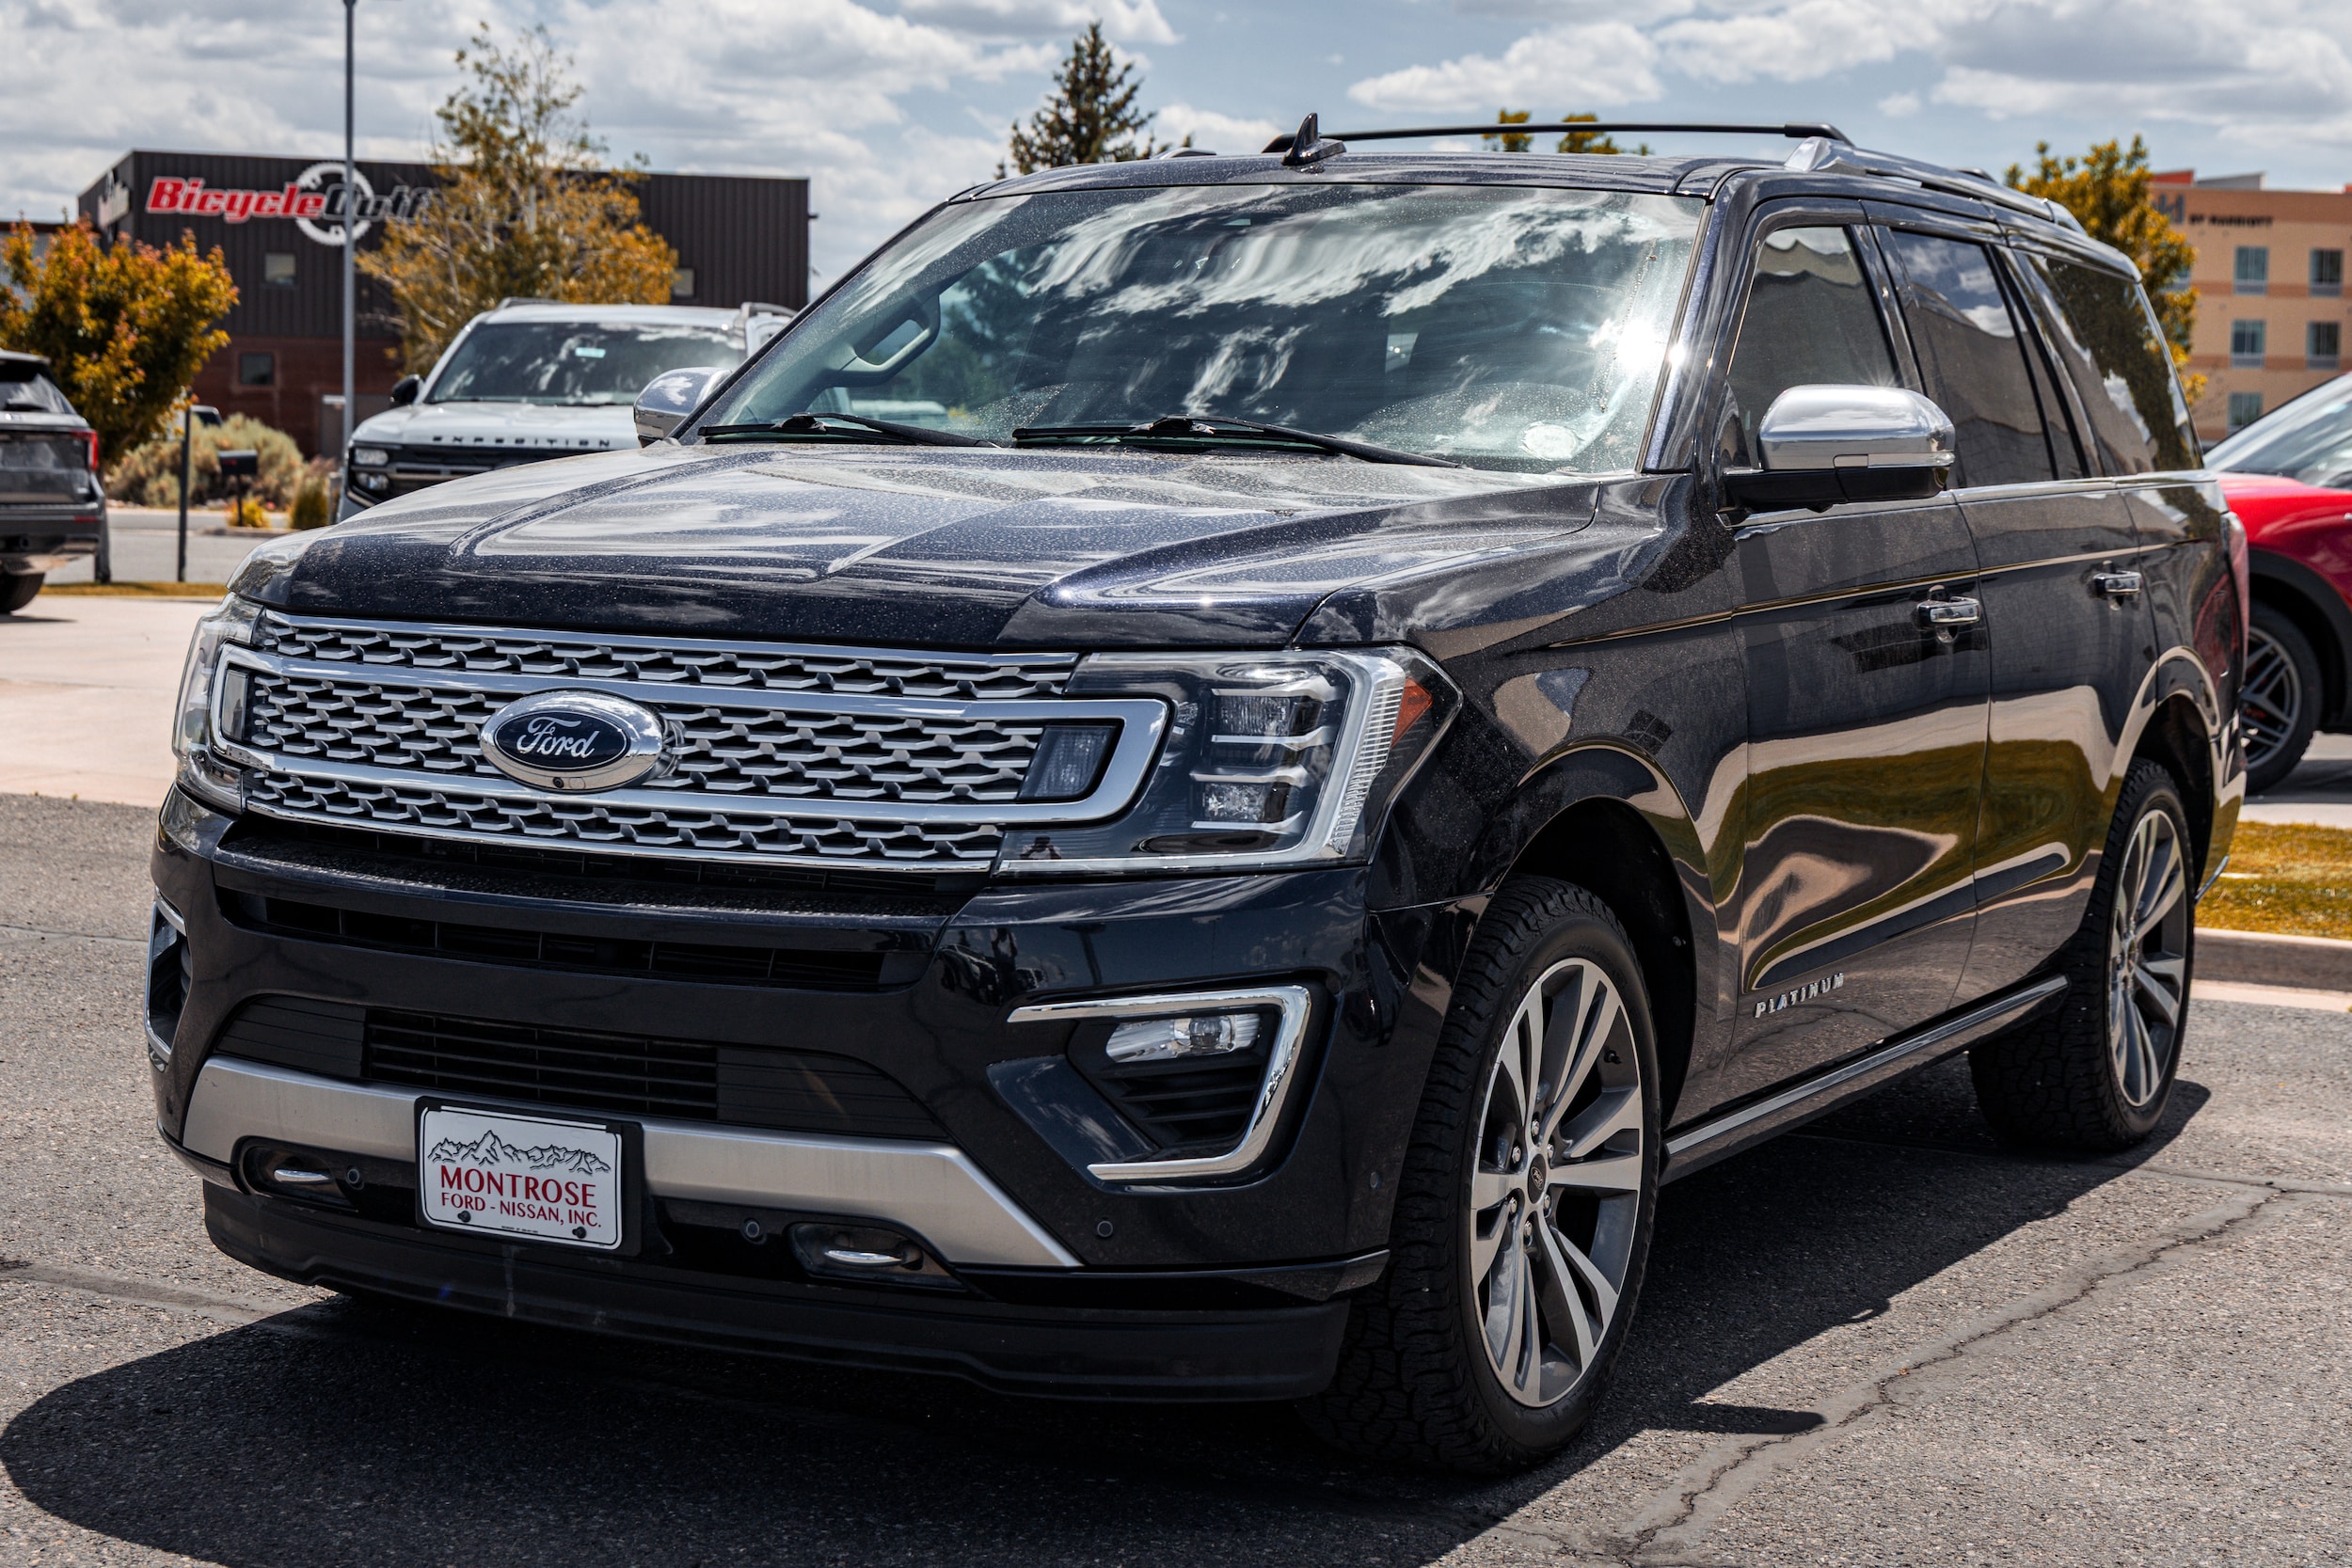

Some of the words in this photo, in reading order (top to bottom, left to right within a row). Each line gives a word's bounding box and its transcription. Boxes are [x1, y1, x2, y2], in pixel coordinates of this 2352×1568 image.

[146, 177, 326, 223] Bicycle
[433, 436, 611, 448] EXPEDITION
[516, 716, 600, 759] Ford
[1754, 972, 1844, 1018] PLATINUM
[440, 1164, 597, 1209] MONTROSE
[441, 1192, 486, 1212] FORD
[500, 1200, 564, 1226] NISSAN,
[568, 1209, 602, 1227] INC.
